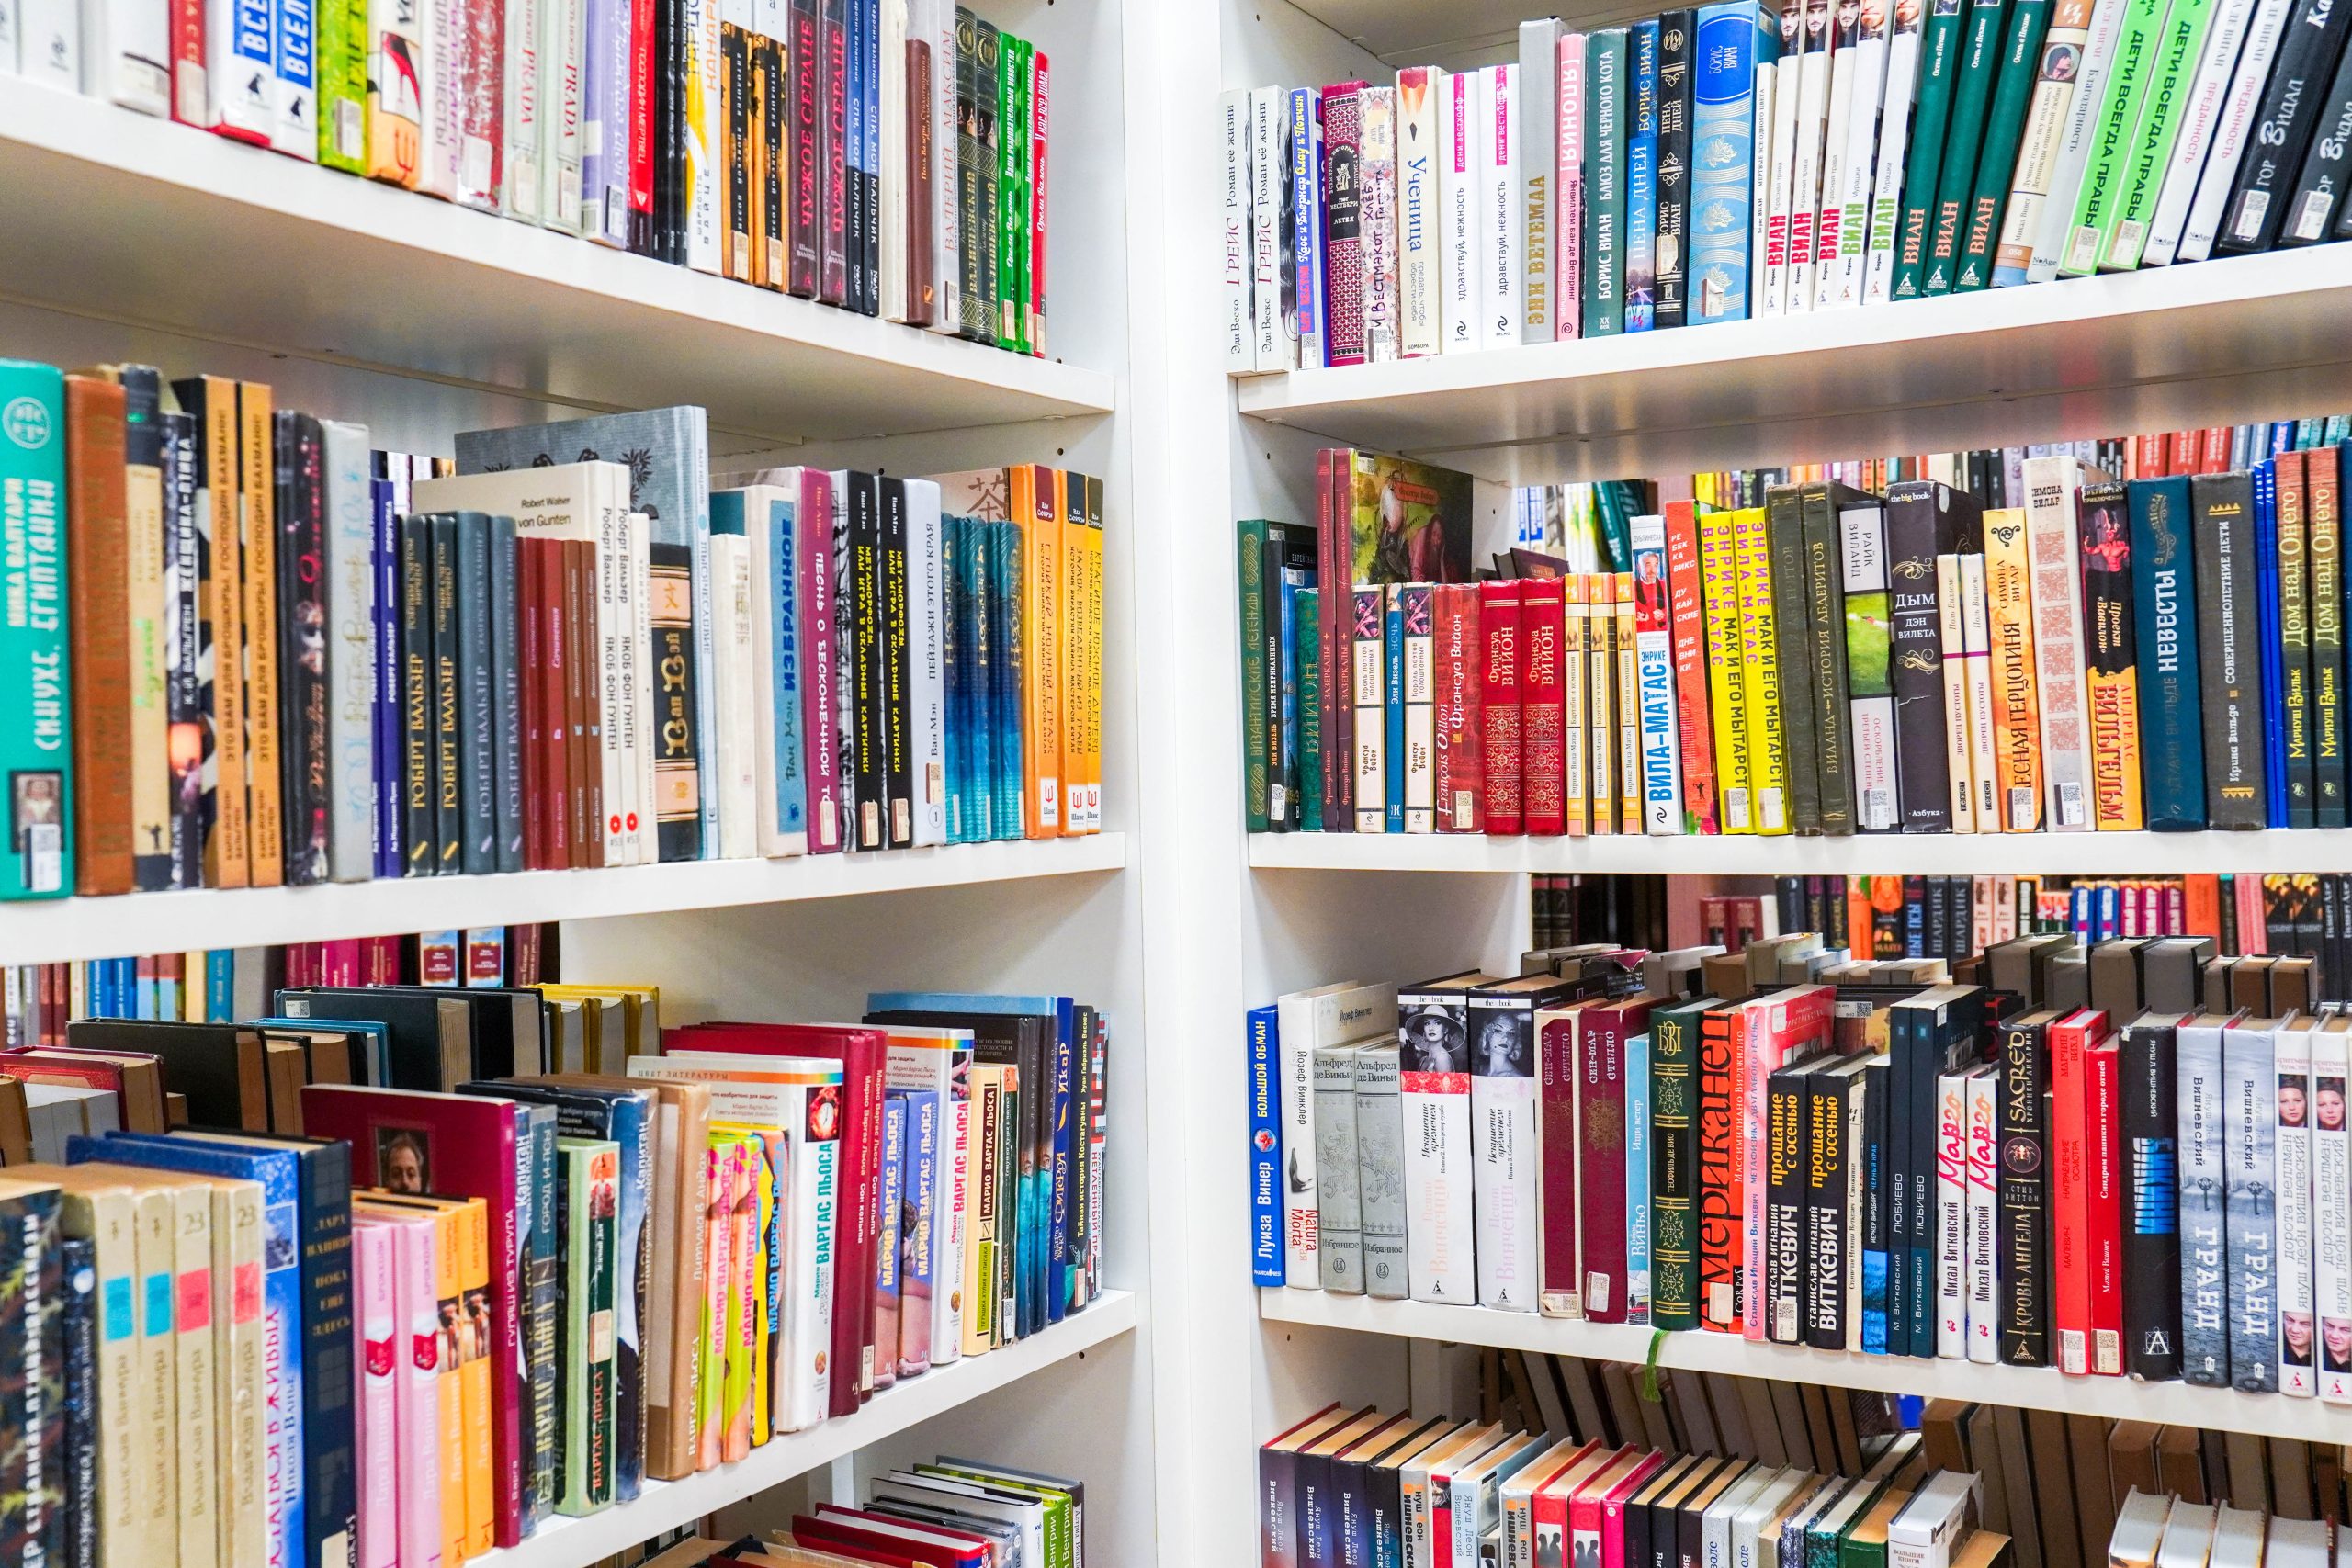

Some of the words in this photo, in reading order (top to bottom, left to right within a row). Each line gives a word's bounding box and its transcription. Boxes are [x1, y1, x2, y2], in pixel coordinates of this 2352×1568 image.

[1005, 49, 1015, 86] невестки
[1600, 51, 1613, 82] КОТА
[1640, 34, 1651, 74] ВИАН
[2125, 30, 2143, 80] ДЕТИ
[1005, 88, 1015, 154] очаровательные
[1226, 105, 1236, 145] жизни
[1600, 85, 1613, 137] ЧЕРНОГО
[1639, 79, 1650, 131] БОРИС
[2101, 74, 2132, 158] ВСЕГДА
[2184, 82, 2217, 164] ПРЕДАННОСТЬ
[1005, 156, 1015, 177] Наши
[1227, 149, 1236, 162] её
[1455, 145, 1465, 167] дени
[1600, 139, 1613, 164] ДЛЯ
[1631, 146, 1647, 199] ДНЕЙ
[802, 130, 814, 225] ЧУЖОЕ
[1226, 165, 1238, 208] Роман
[1600, 166, 1613, 200] БЛЮЗ
[1408, 156, 1426, 252] Ученица
[1455, 187, 1464, 237] нежность
[1529, 175, 1544, 274] ВЕТЕМАА
[1599, 214, 1611, 250] ВИАН
[1842, 204, 1864, 254] ВИАН
[1904, 209, 1925, 264] ВИАН
[1455, 240, 1465, 301] здравствуй,
[1599, 254, 1611, 299] БОРИС
[1230, 299, 1240, 331] Веско
[1529, 277, 1544, 324] ЭНН
[1229, 333, 1240, 354] Эди
[925, 523, 933, 559] КРАЯ
[2219, 521, 2232, 553] ДЕТИ
[2278, 491, 2300, 555] Онего
[815, 553, 825, 610] ПЕСНЬ
[926, 563, 934, 606] ЭТОГО
[1717, 526, 1735, 609] ЭНРИКЕ
[1812, 542, 1830, 623] АБДЕРИТОВ
[1997, 560, 2007, 609] СИМОНА
[2010, 565, 2020, 602] ВИЛАР
[2286, 559, 2301, 596] над
[780, 519, 795, 691] ИЗБРАННОЕ
[1702, 527, 1723, 665] ВИЛА-МАТАС
[1896, 594, 1935, 607] ДЫМ
[817, 620, 825, 632] О
[1390, 623, 1398, 650] НОЧЬ
[1451, 615, 1462, 657] Вийон
[2155, 569, 2177, 672] НЕВЕСТЫ
[2221, 557, 2235, 683] СОВЕРШЕННОЛЕТНИЕ
[2283, 599, 2306, 646] Дом
[605, 637, 616, 669] ЯКОБ
[925, 610, 936, 679] ПЕЙЗАЖИ
[1269, 636, 1277, 693] НЕПРИКАЯННЫХ
[1489, 632, 1501, 682] Франсуа
[1499, 627, 1514, 686] ВИЙОН
[1818, 630, 1834, 698] ИСТОРИЯ
[410, 653, 424, 730] ВАЛЬЗЕР
[605, 674, 616, 702] ФОН
[1323, 644, 1331, 700] ЗАЗЕРКАЛЬЕ
[1390, 656, 1399, 686] Визель
[2003, 623, 2027, 722] ГЕРЦОГИНЯ
[816, 640, 830, 775] БЕСКОНЕЧНОЙ
[929, 703, 938, 725] Мэн
[1390, 689, 1399, 704] Эли
[1451, 662, 1464, 728] Франсуа
[606, 705, 617, 750] ГУНТЕН
[930, 728, 938, 756] Ван
[1642, 664, 1672, 801] ВИЛА-МАТАС
[1824, 715, 1838, 773] ВИЛАНД
[2227, 705, 2239, 742] Вильде
[412, 740, 426, 807] РОБЕРТ
[2227, 746, 2242, 782] Ирина
[1256, 1021, 1266, 1059] ОБМАН
[1080, 1077, 1088, 1093] Хуан
[1296, 1051, 1307, 1083] Йозеф
[2098, 1061, 2107, 1084] огней
[985, 1090, 995, 1127] ЛЬОСА
[1255, 1063, 1268, 1117] БОЛЬШОЙ
[1296, 1085, 1306, 1124] Винклер
[2099, 1086, 2109, 1116] городе
[1077, 1102, 1088, 1158] Костагуаны
[1811, 1095, 1825, 1188] прощание
[1825, 1096, 1838, 1158] осенью
[2100, 1125, 2109, 1157] паники
[2192, 1077, 2204, 1166] Вишневский
[818, 1142, 833, 1196] ЛЬОСА
[984, 1132, 994, 1169] ВАРГАС
[983, 1175, 993, 1213] МАРИО
[1077, 1161, 1087, 1200] история
[1257, 1162, 1271, 1205] Винер
[1667, 1160, 1675, 1192] ТЕОФИЛЬ
[2099, 1160, 2109, 1199] Синдром
[1076, 1203, 1086, 1237] Тайная
[1894, 1173, 1904, 1233] ЛЮБИЕВО
[816, 1200, 832, 1264] ВАРГАС
[1258, 1215, 1272, 1258] Луиза
[1291, 1209, 1302, 1246] Morta
[1306, 1210, 1317, 1250] Natura
[1808, 1206, 1819, 1258] игнаций
[1943, 1202, 1959, 1260] Витковский
[2015, 1213, 2031, 1273] АНГЕЛА
[2102, 1240, 2110, 1267] Вишнек
[1944, 1265, 1959, 1297] Михал
[2102, 1269, 2112, 1293] Матей
[2195, 1227, 2220, 1330] ГРАНД
[2016, 1278, 2033, 1326] КРОВЬ
